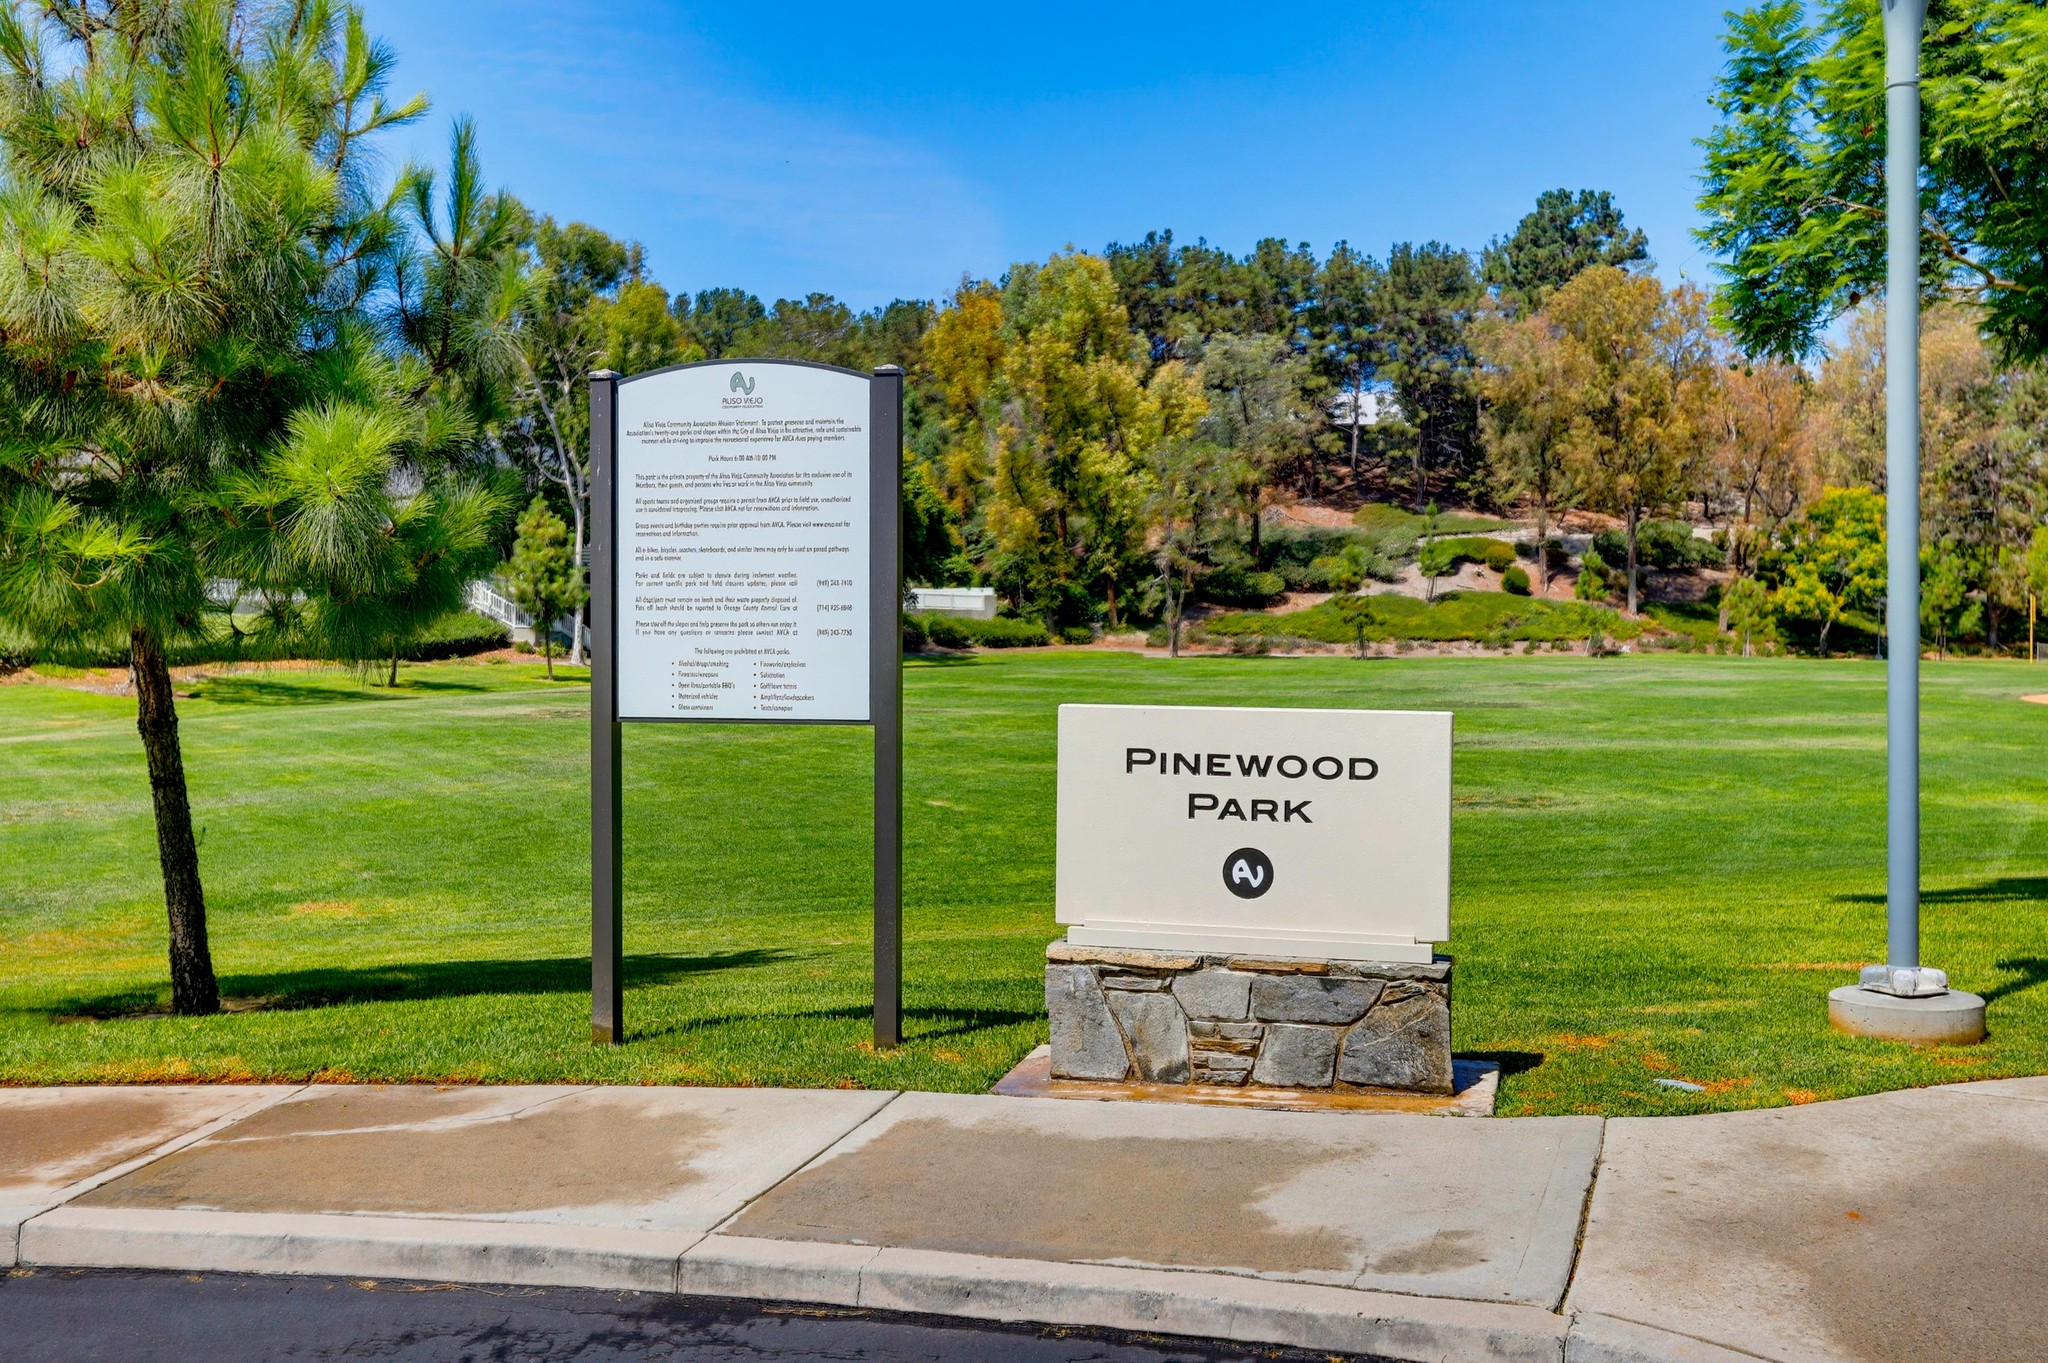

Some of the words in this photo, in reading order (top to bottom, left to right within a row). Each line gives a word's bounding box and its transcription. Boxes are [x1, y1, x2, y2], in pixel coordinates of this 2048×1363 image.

[722, 397, 742, 405] ALISO
[743, 397, 764, 405] VIEJO
[1126, 747, 1379, 781] PINEWOOD
[1187, 793, 1313, 824] PARK
